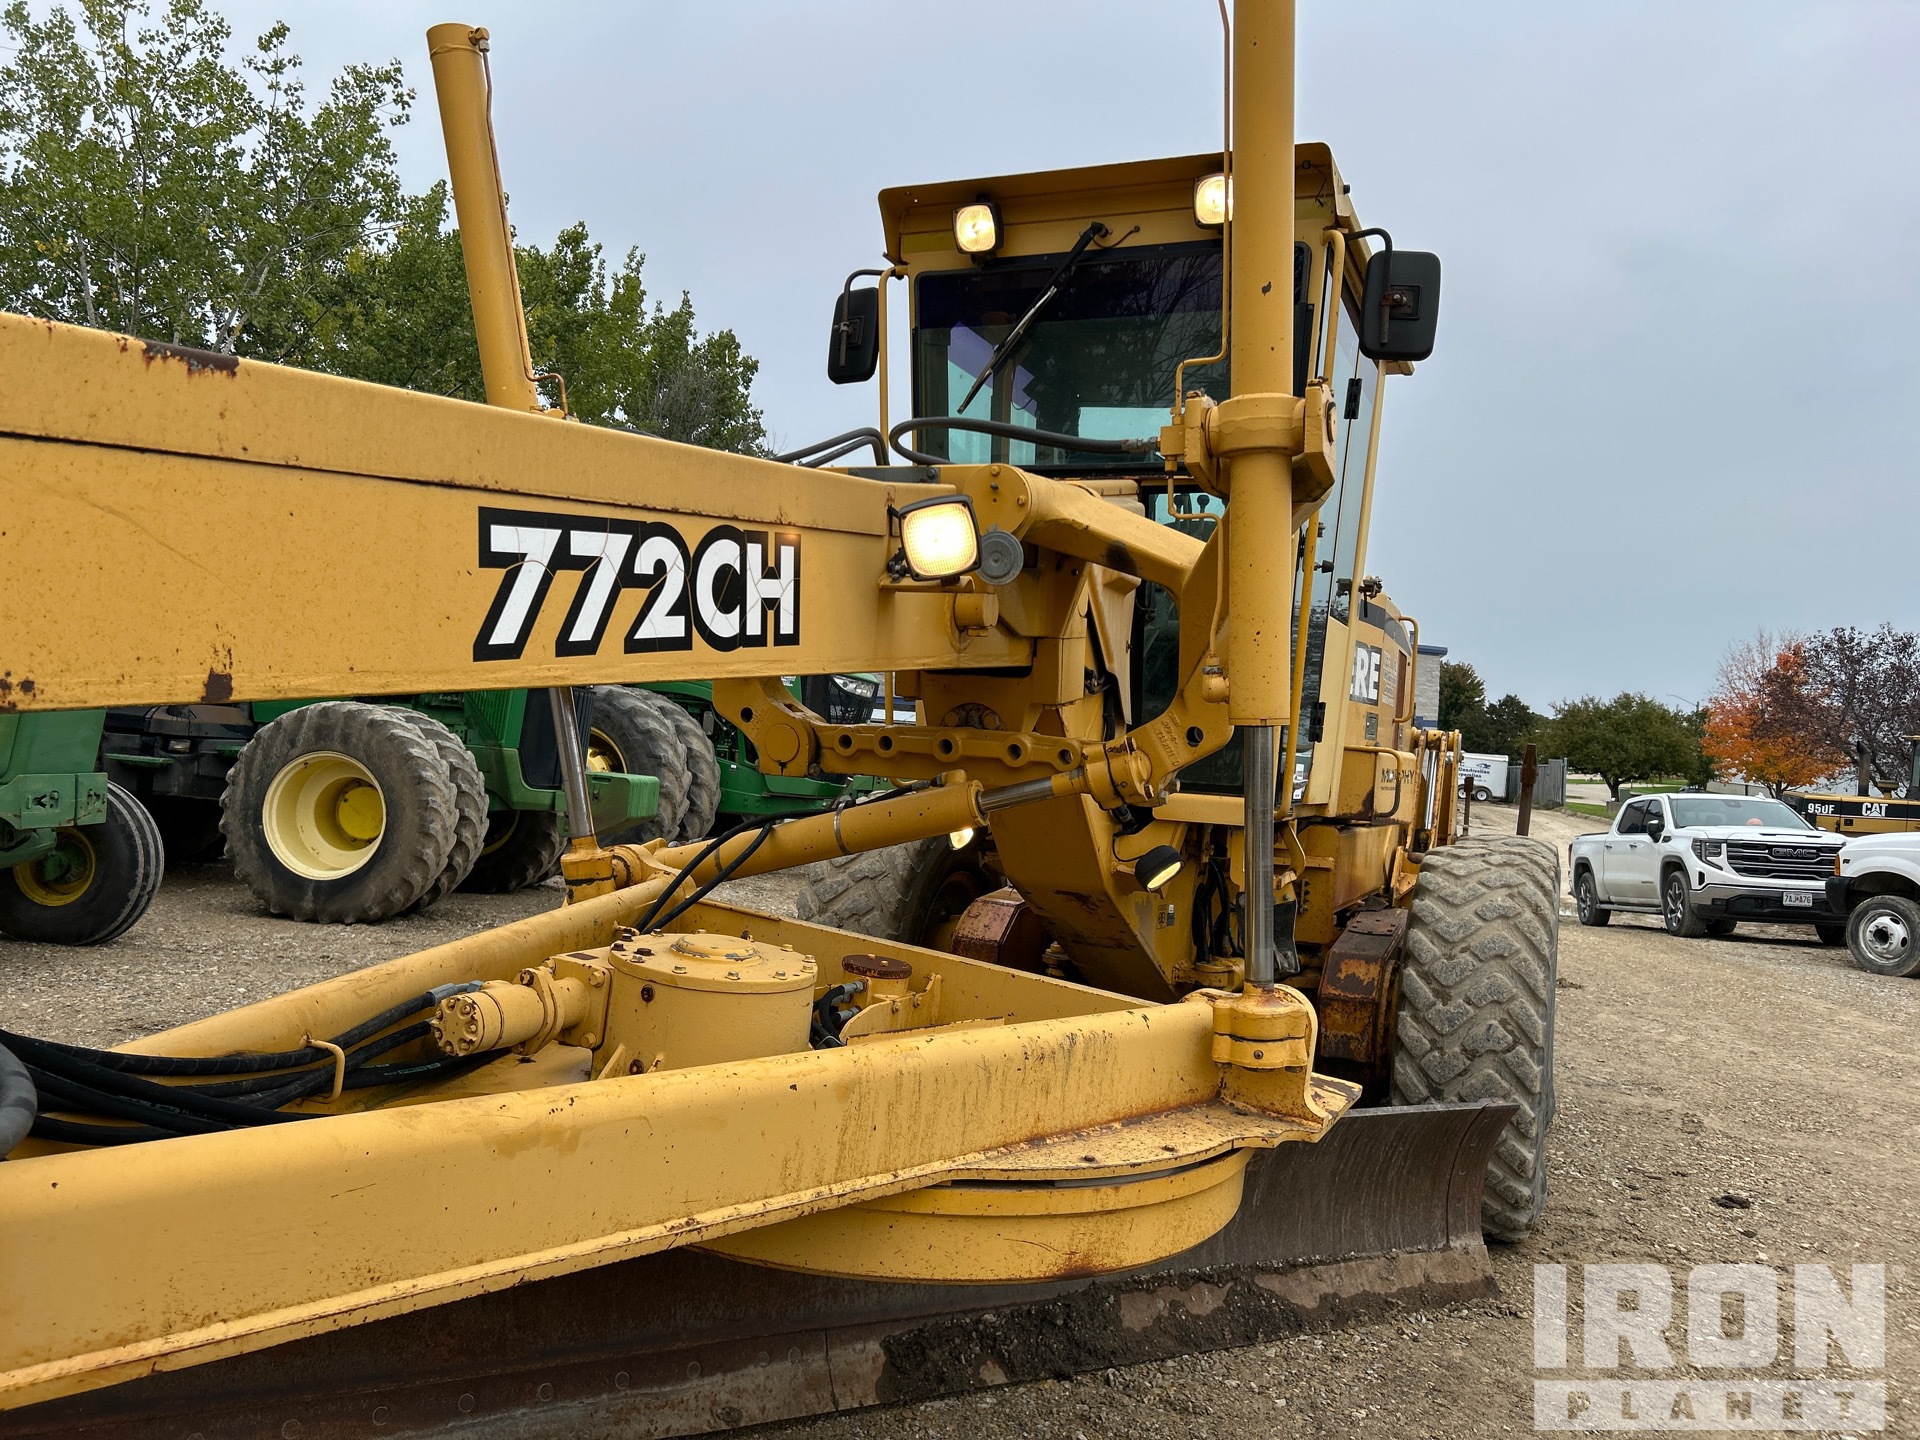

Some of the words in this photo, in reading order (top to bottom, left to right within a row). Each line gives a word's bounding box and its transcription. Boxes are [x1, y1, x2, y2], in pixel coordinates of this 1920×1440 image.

[486, 522, 796, 647] 772CH
[1350, 647, 1381, 700] RE
[1807, 802, 1835, 814] 950F
[1861, 802, 1889, 817] CAT
[1772, 847, 1817, 858] GMC
